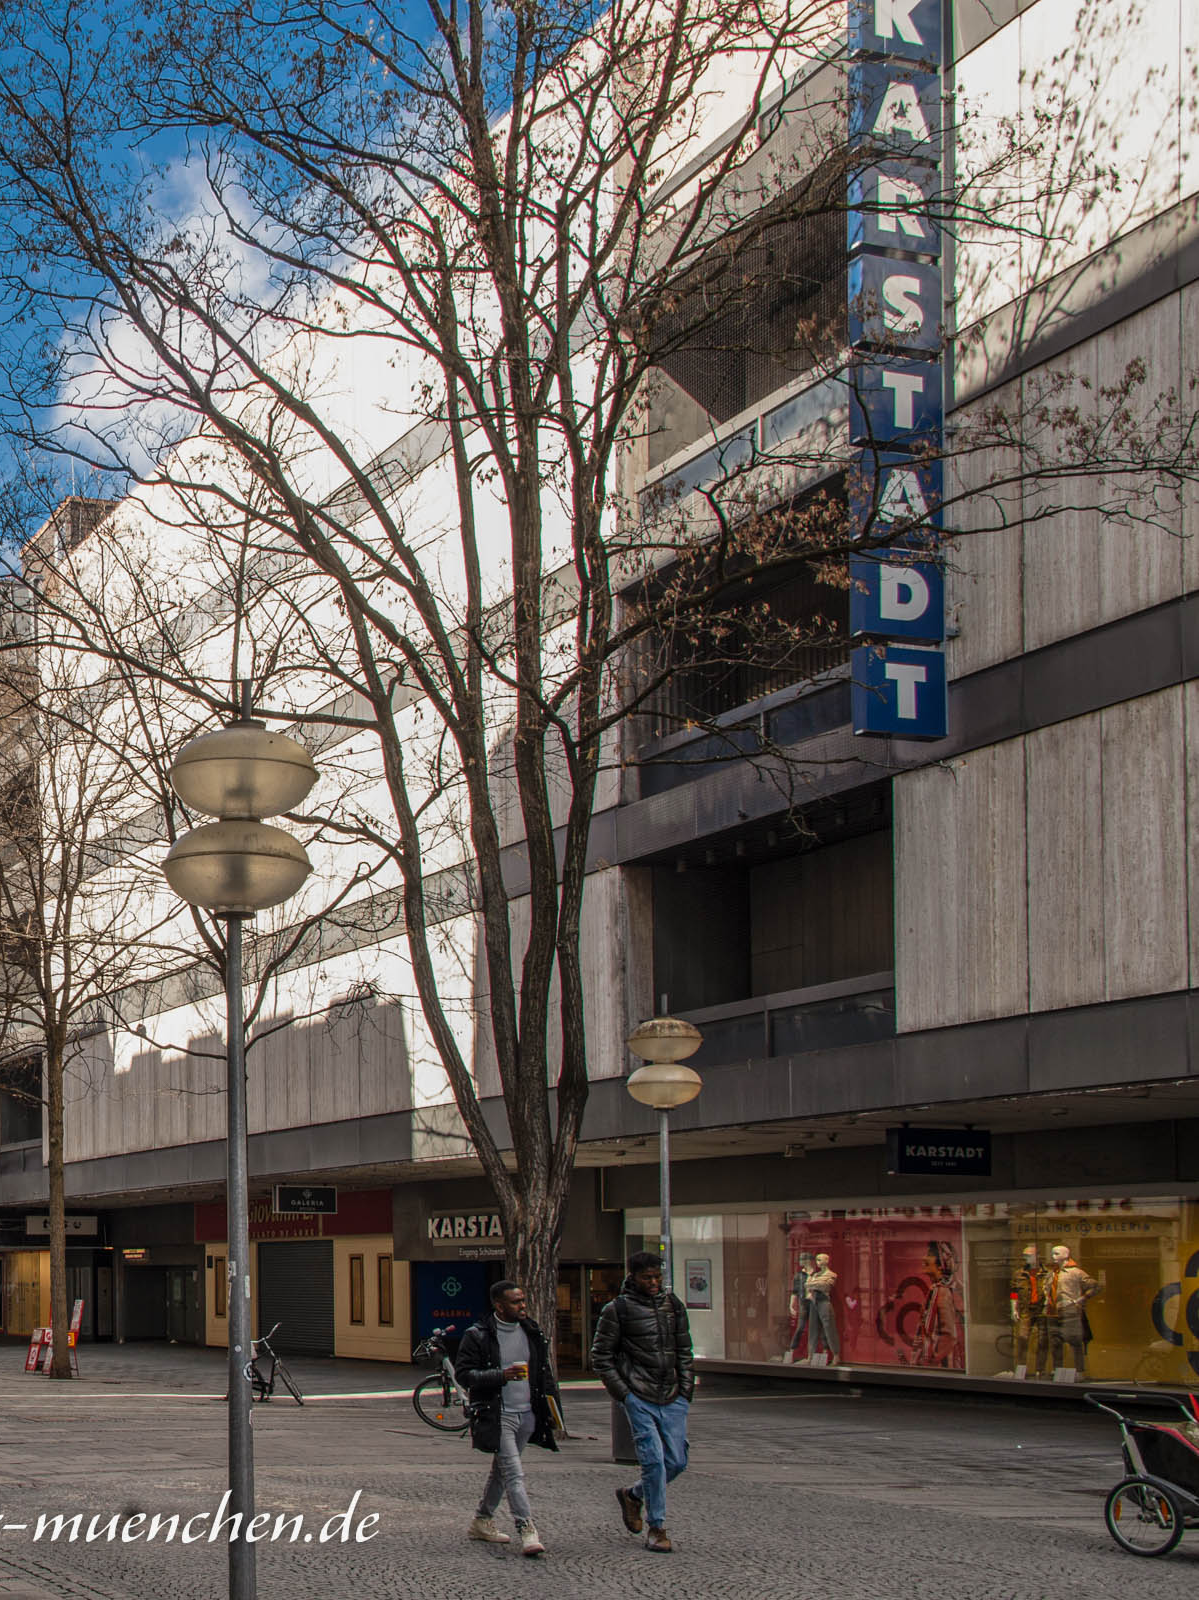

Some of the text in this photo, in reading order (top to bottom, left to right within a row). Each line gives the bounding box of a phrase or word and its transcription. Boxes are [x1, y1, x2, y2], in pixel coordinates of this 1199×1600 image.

[873, 0, 932, 720] KARSTADT
[905, 1145, 985, 1158] KARSTADT
[290, 1199, 325, 1207] GALERIA
[427, 1215, 503, 1239] KARSTA
